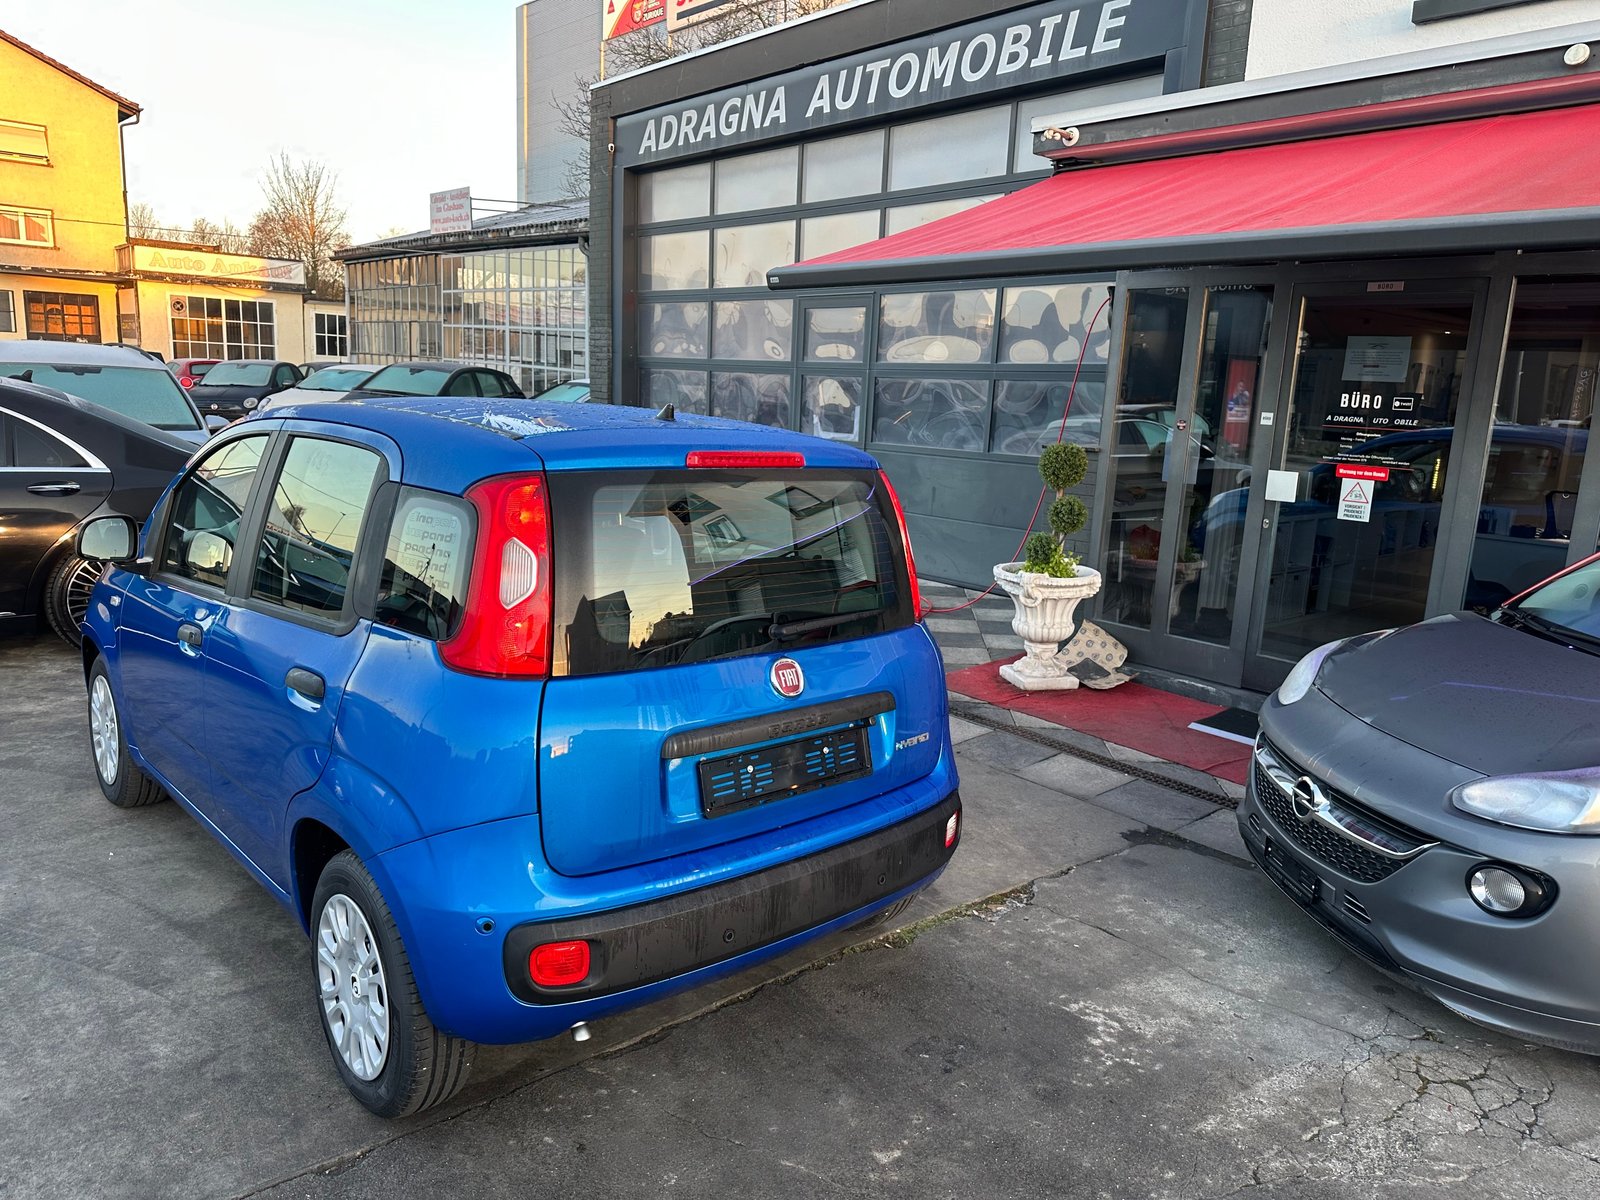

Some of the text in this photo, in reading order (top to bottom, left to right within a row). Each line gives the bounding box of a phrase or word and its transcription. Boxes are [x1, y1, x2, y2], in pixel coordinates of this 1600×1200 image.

[638, 0, 1132, 155] ADRAGNA AUTOMOBILE
[149, 251, 206, 271] Auto
[1340, 391, 1383, 409] BÜRO
[1333, 415, 1364, 423] DRAGNA
[1372, 417, 1389, 425] UTO
[1394, 418, 1420, 426] OBILE
[1339, 468, 1356, 476] Warnung
[778, 667, 799, 688] FIAT
[895, 732, 929, 751] HYBRID
